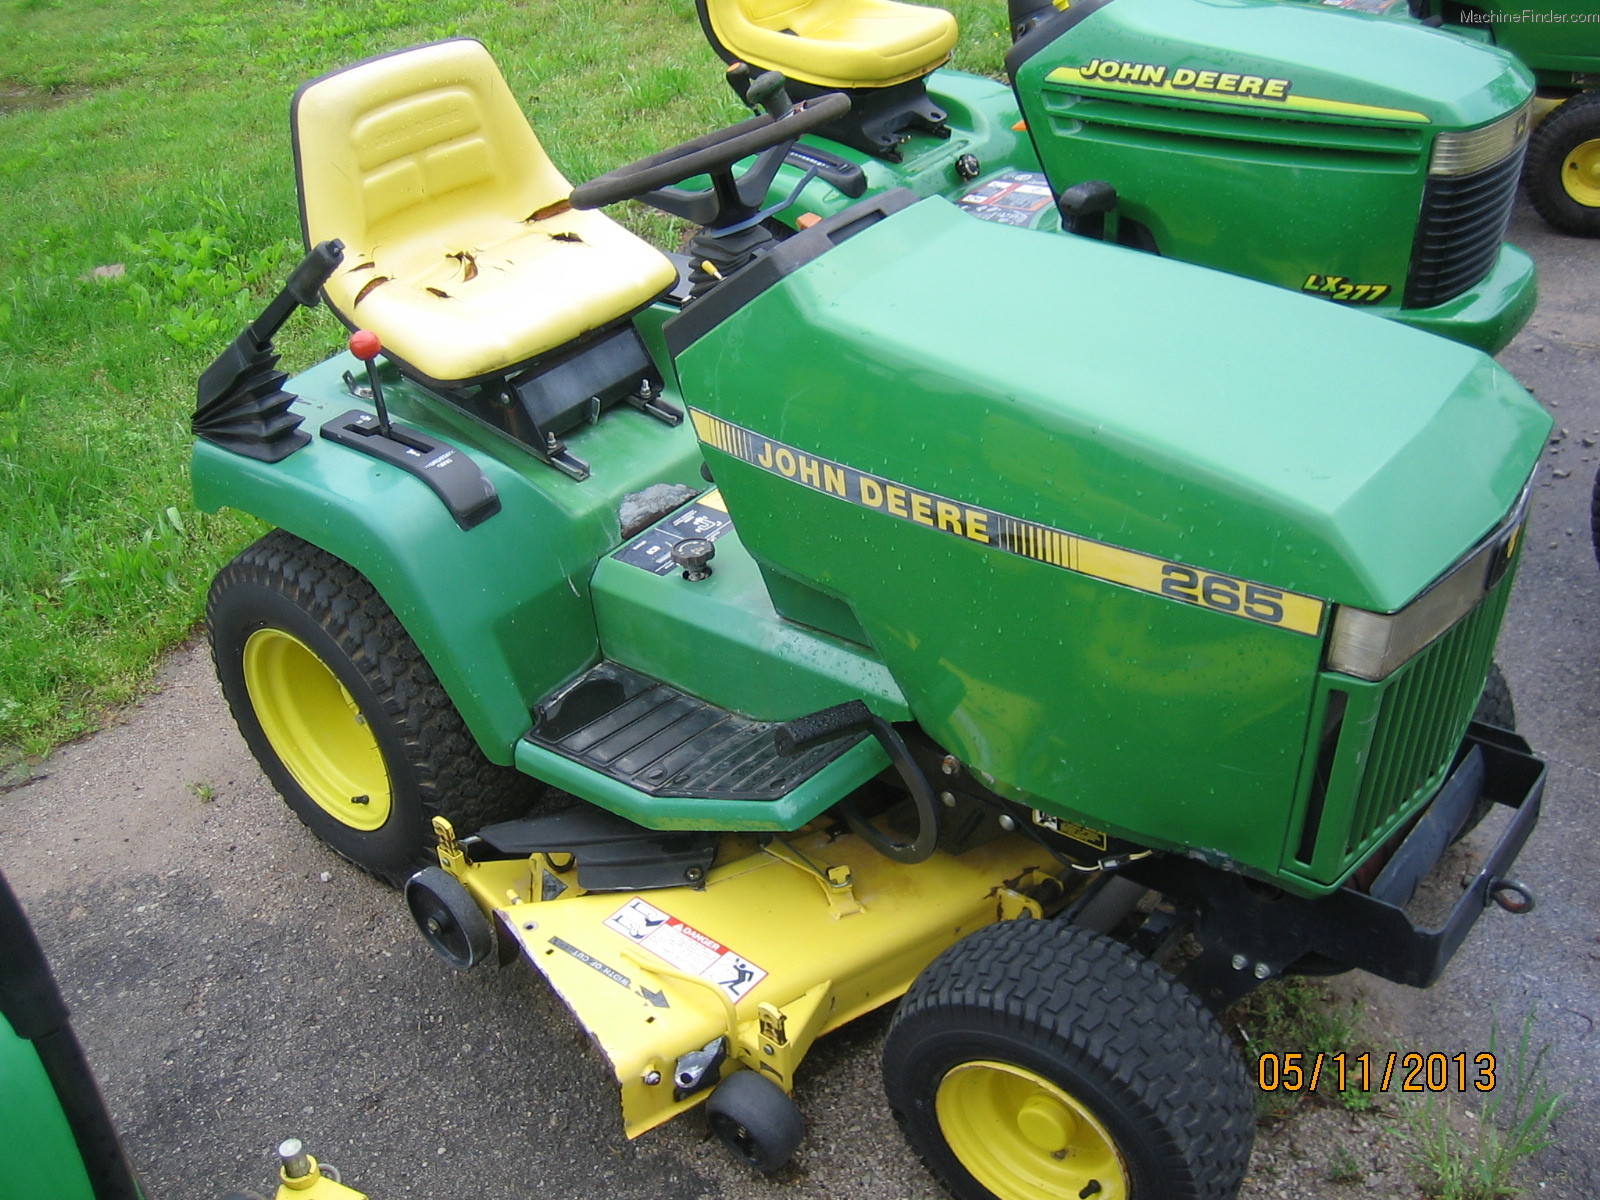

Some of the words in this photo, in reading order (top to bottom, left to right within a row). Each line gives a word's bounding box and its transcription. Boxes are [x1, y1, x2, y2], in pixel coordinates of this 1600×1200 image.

[1079, 58, 1168, 88] JOHN
[1170, 67, 1293, 101] DEERE
[1302, 273, 1391, 304] LX277
[757, 442, 847, 497] JOHN
[859, 475, 991, 544] DEERE
[1161, 564, 1284, 623] 265
[682, 926, 721, 951] DANGER
[571, 950, 590, 962] CUT
[589, 961, 603, 970] OF
[602, 967, 629, 986] WIDTH
